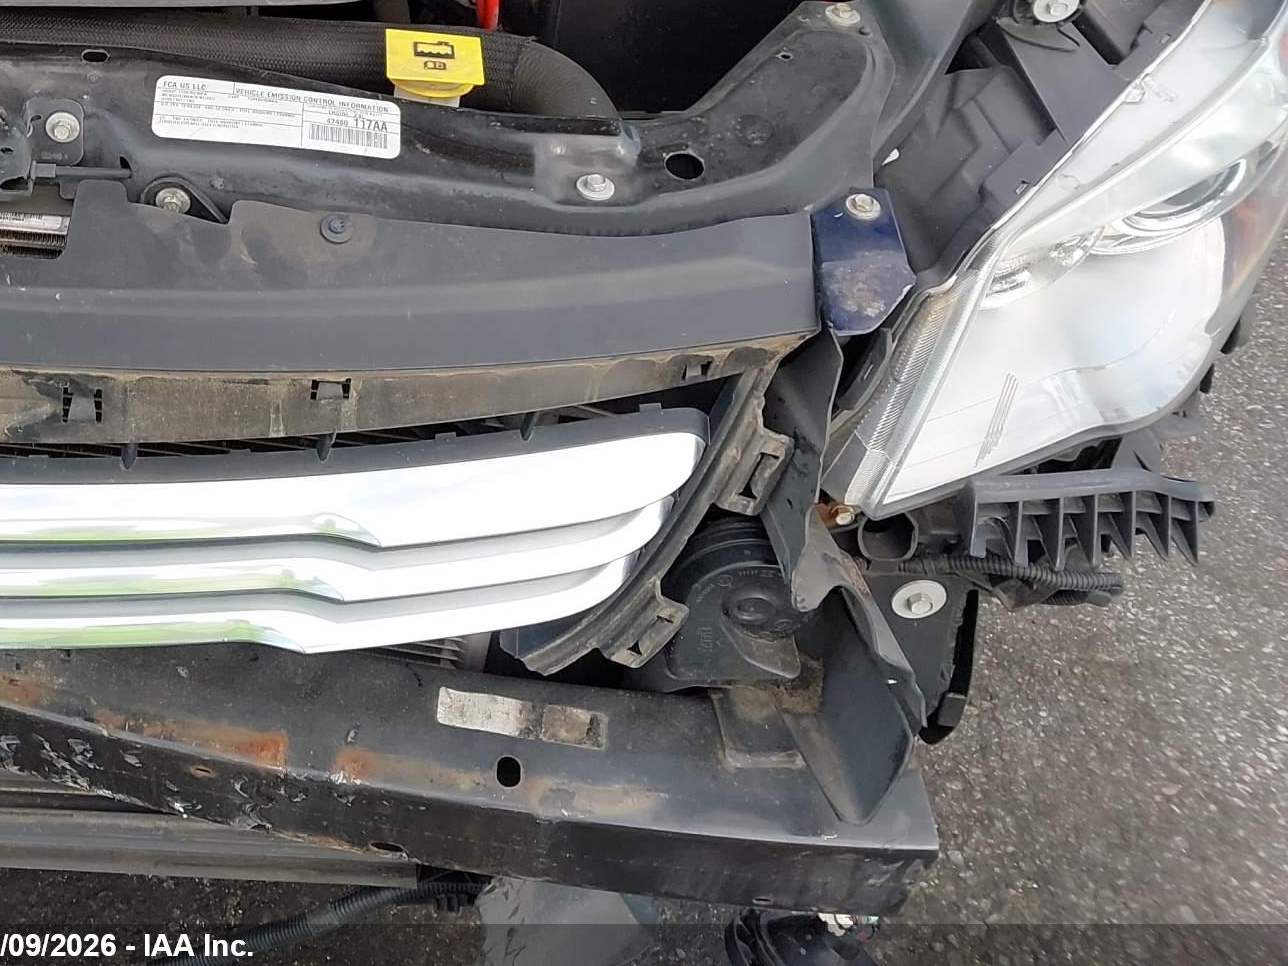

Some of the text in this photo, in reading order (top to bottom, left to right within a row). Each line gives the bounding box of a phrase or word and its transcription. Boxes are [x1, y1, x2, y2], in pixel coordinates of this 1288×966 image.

[163, 81, 207, 91] FCA US LLC
[235, 88, 265, 98] VEHICLE
[267, 91, 301, 102] EMISSION
[304, 96, 336, 106] CONTROL
[339, 101, 389, 113] INFORMATION
[353, 118, 388, 132] 117AA
